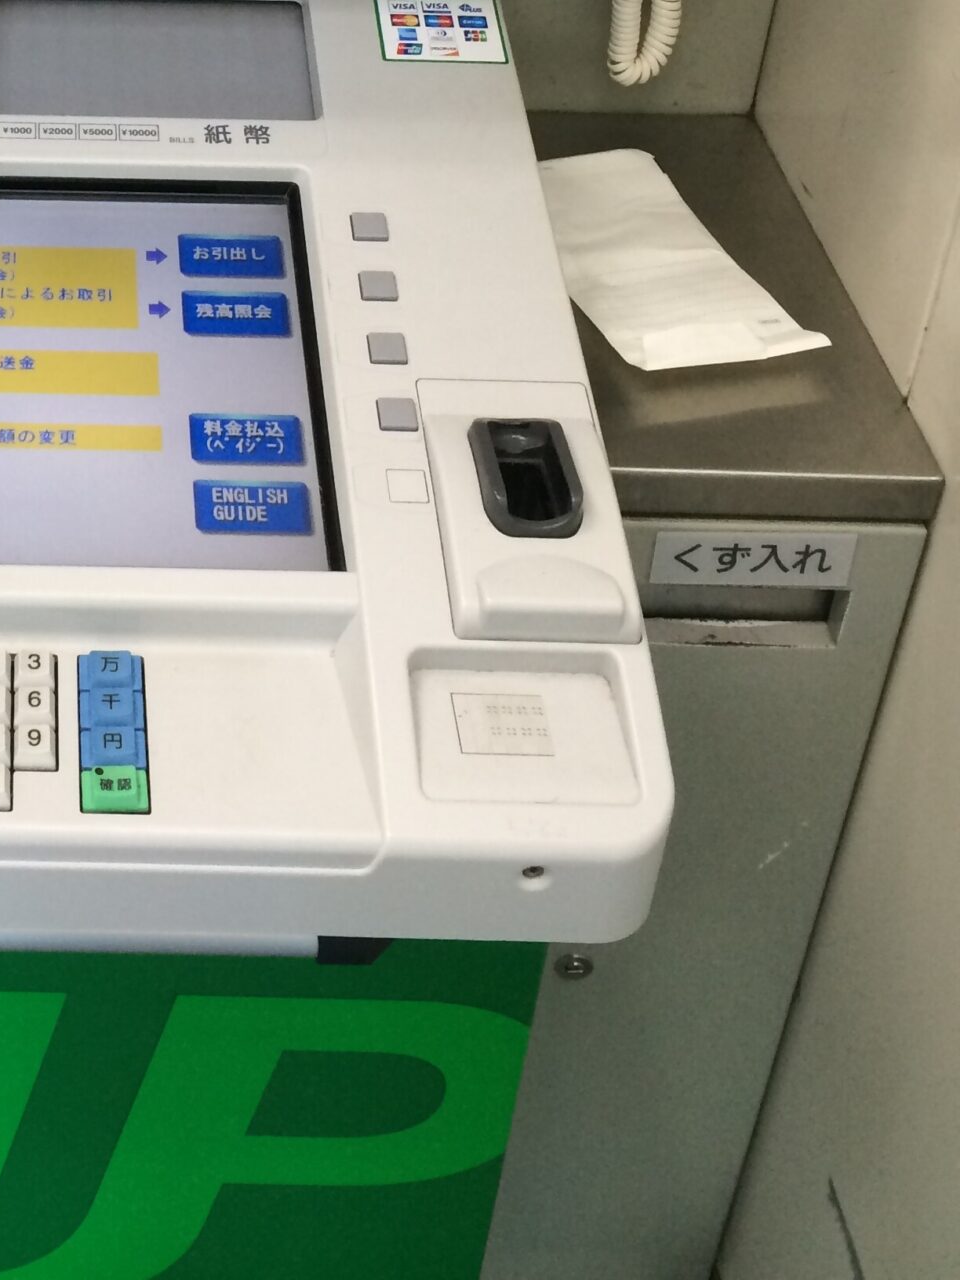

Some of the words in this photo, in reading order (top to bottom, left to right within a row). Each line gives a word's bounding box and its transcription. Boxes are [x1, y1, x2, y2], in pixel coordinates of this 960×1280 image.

[3, 127, 32, 135] ¥1000
[43, 128, 73, 136] ¥2000
[83, 128, 113, 137] ¥5000
[121, 129, 157, 138] ¥10000
[192, 246, 266, 261] お引出し
[196, 304, 273, 319] 残高照会
[203, 420, 285, 437] 料金払込
[212, 487, 288, 504] ENGLISH
[213, 505, 268, 522] GUIDE
[674, 543, 832, 574] くず入れ
[27, 654, 41, 670] 3
[100, 657, 120, 672] 万
[27, 691, 41, 707] 6
[102, 694, 120, 710] 千
[27, 729, 41, 746] 9
[103, 732, 122, 749] 円
[99, 778, 131, 791] 確認
